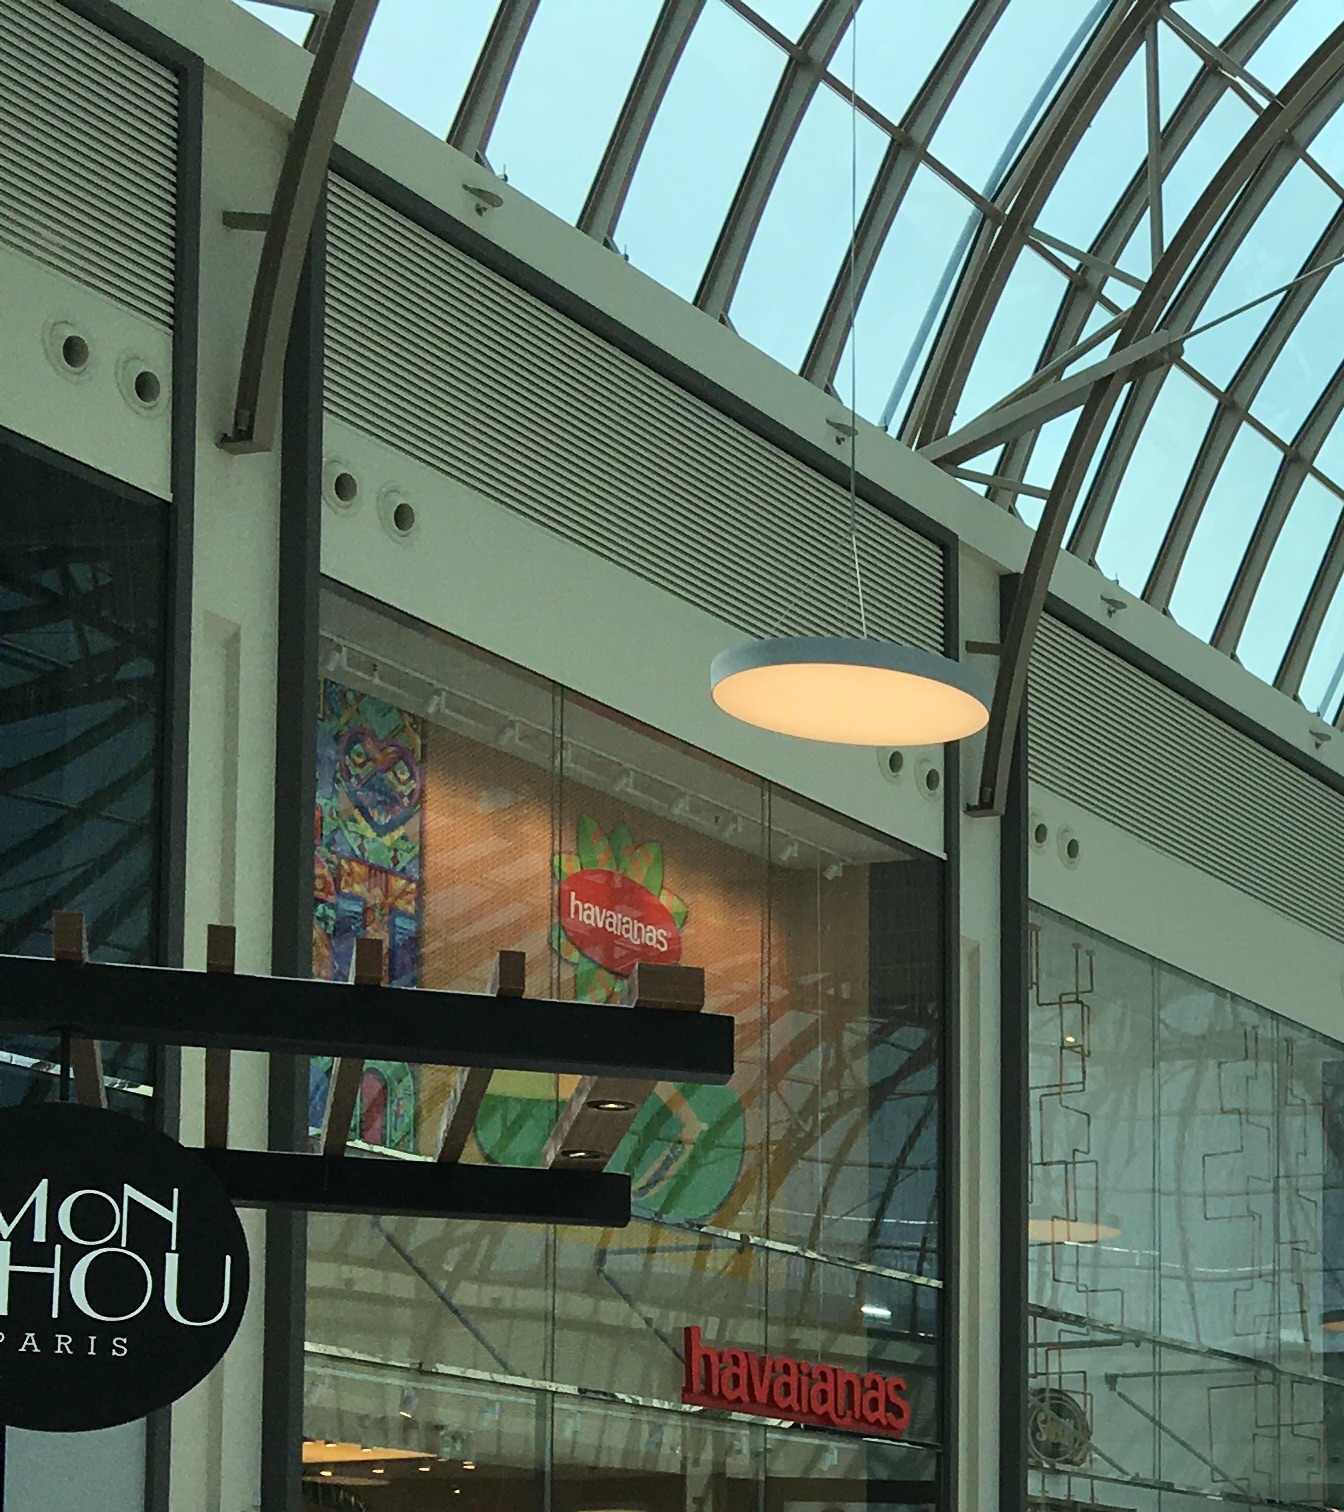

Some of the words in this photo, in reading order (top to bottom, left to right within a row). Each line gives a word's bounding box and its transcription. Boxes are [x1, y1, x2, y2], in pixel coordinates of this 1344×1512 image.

[570, 891, 668, 952] havaianas
[0, 1240, 231, 1326] HOU
[683, 1325, 911, 1430] havaianas
